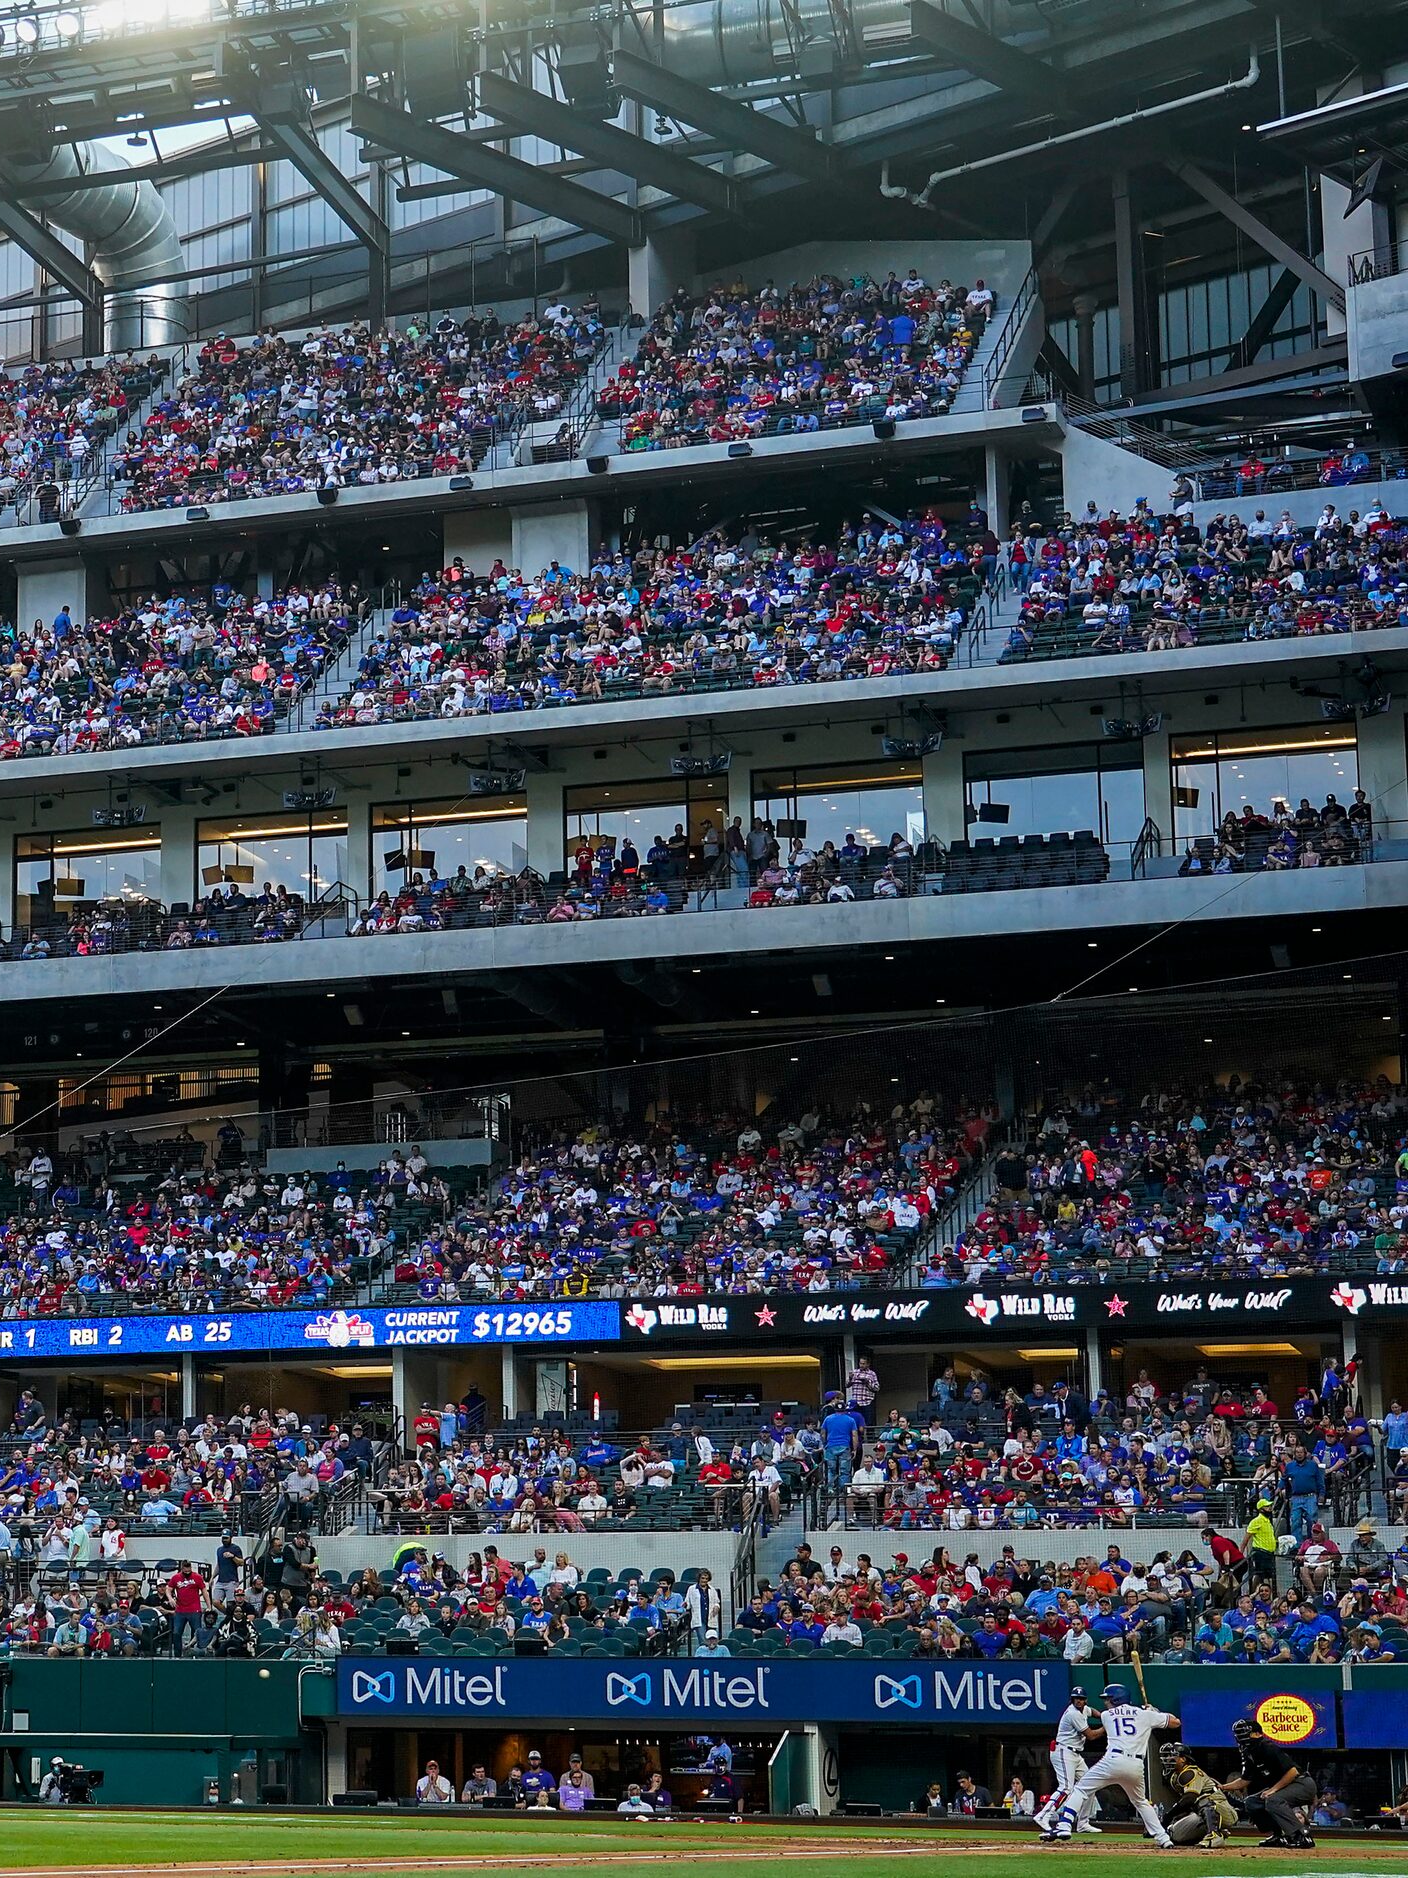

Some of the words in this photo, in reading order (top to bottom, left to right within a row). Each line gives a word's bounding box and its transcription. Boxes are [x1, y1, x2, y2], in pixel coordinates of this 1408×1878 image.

[24, 1036, 36, 1046] 121
[1001, 1295, 1040, 1315] WILD
[1043, 1294, 1074, 1315] RAG
[1157, 1294, 1201, 1311] What's
[1208, 1293, 1238, 1310] Your
[1245, 1289, 1291, 1310] Wild?
[386, 1312, 460, 1327] CURRENT
[658, 1305, 695, 1325] WILD
[698, 1304, 727, 1325] RAG
[804, 1305, 845, 1322] What's
[851, 1304, 880, 1321] Your
[885, 1300, 929, 1320] Wild?
[26, 1329, 35, 1347] 1
[70, 1329, 97, 1345] RBI
[109, 1326, 122, 1344] 2
[166, 1325, 192, 1341] AB
[205, 1322, 231, 1341] 25
[308, 1326, 329, 1336] TEXAS
[350, 1325, 370, 1335] SPLIT
[473, 1312, 571, 1338] $12965
[385, 1329, 459, 1345] JACKPOT
[407, 1667, 506, 1706] Mitel
[664, 1668, 769, 1708] Mitel
[935, 1670, 1046, 1710] Mitel
[1108, 1709, 1138, 1717] SOLAK
[1262, 1712, 1308, 1723] Barbecue
[1113, 1718, 1136, 1736] 15
[1272, 1723, 1300, 1734] Sauce
